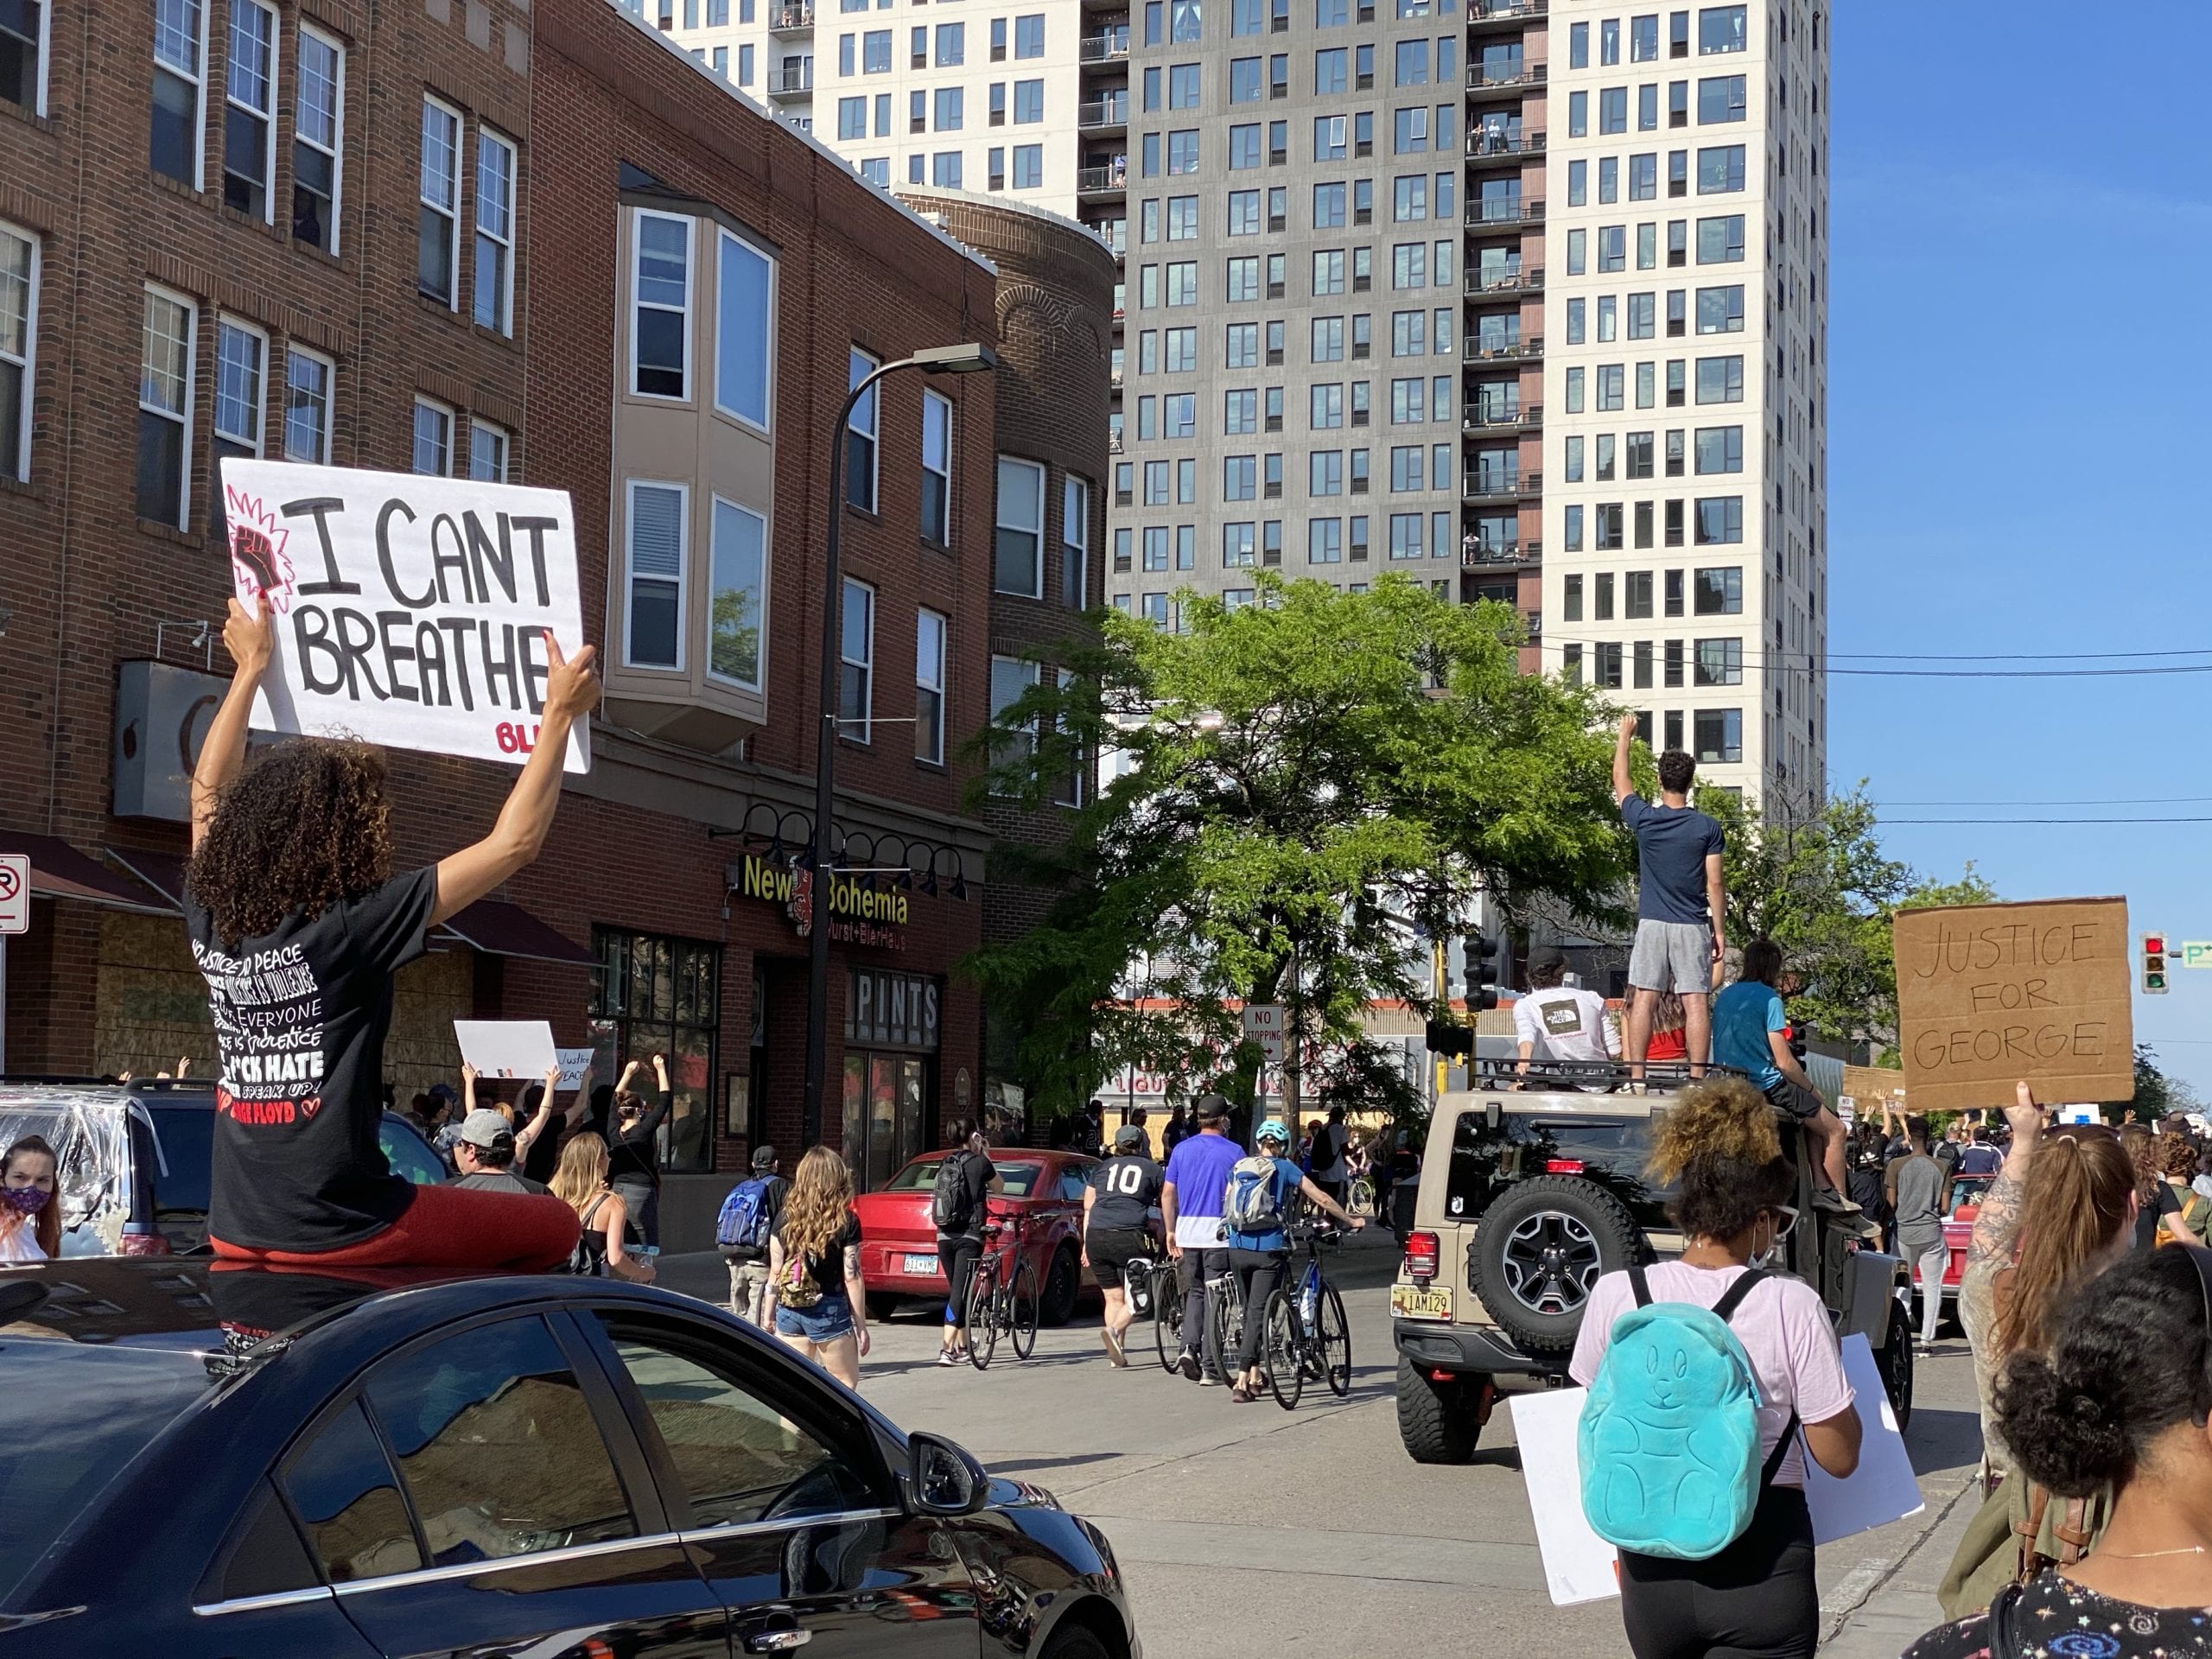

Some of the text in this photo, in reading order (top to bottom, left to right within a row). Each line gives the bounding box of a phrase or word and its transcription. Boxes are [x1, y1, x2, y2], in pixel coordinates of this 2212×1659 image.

[280, 497, 558, 608] I CANT
[292, 604, 554, 715] BREATHE
[744, 855, 792, 902] New
[254, 944, 304, 974] PEACE
[1915, 922, 2099, 978] JUSTICE
[858, 975, 938, 1029] PINTS
[1971, 978, 2059, 1014] FOR
[236, 998, 322, 1027] EVERYONE
[1255, 1011, 1271, 1024] NO
[1246, 1030, 1281, 1042] STOPPING
[1915, 1022, 2107, 1070] GEORGE
[265, 1051, 324, 1082] HATE
[558, 1052, 590, 1065] Justice
[242, 1085, 286, 1099] SPEAK
[289, 1081, 322, 1096] UP!
[562, 1071, 585, 1082] EACE
[253, 1102, 295, 1124] FLOYD
[1107, 1163, 1142, 1194] 10
